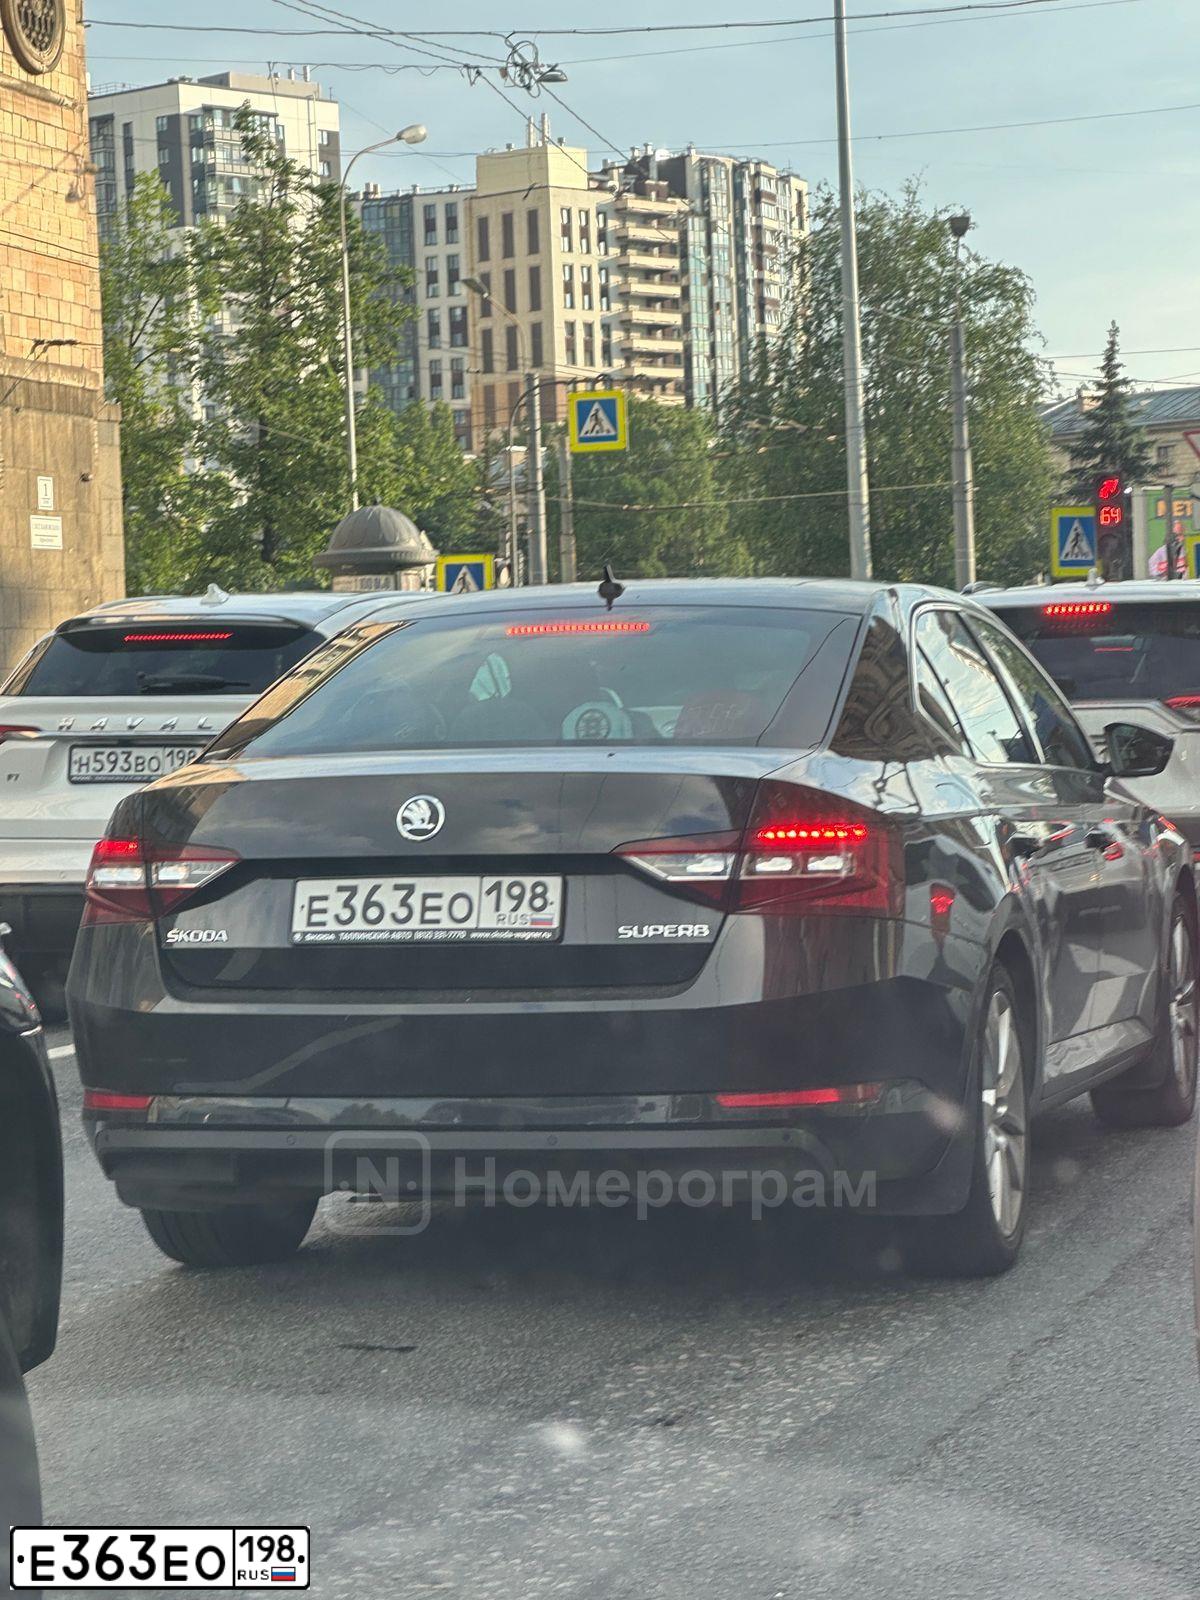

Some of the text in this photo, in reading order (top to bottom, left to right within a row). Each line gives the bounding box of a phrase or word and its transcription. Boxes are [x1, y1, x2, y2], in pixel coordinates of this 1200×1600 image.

[1099, 506, 1121, 526] 64
[57, 716, 213, 731] HAVAL
[77, 750, 161, 773] Н593ВО
[306, 880, 549, 927] Е363ЕО 198
[496, 913, 528, 926] RUS
[617, 924, 710, 939] SUPERB
